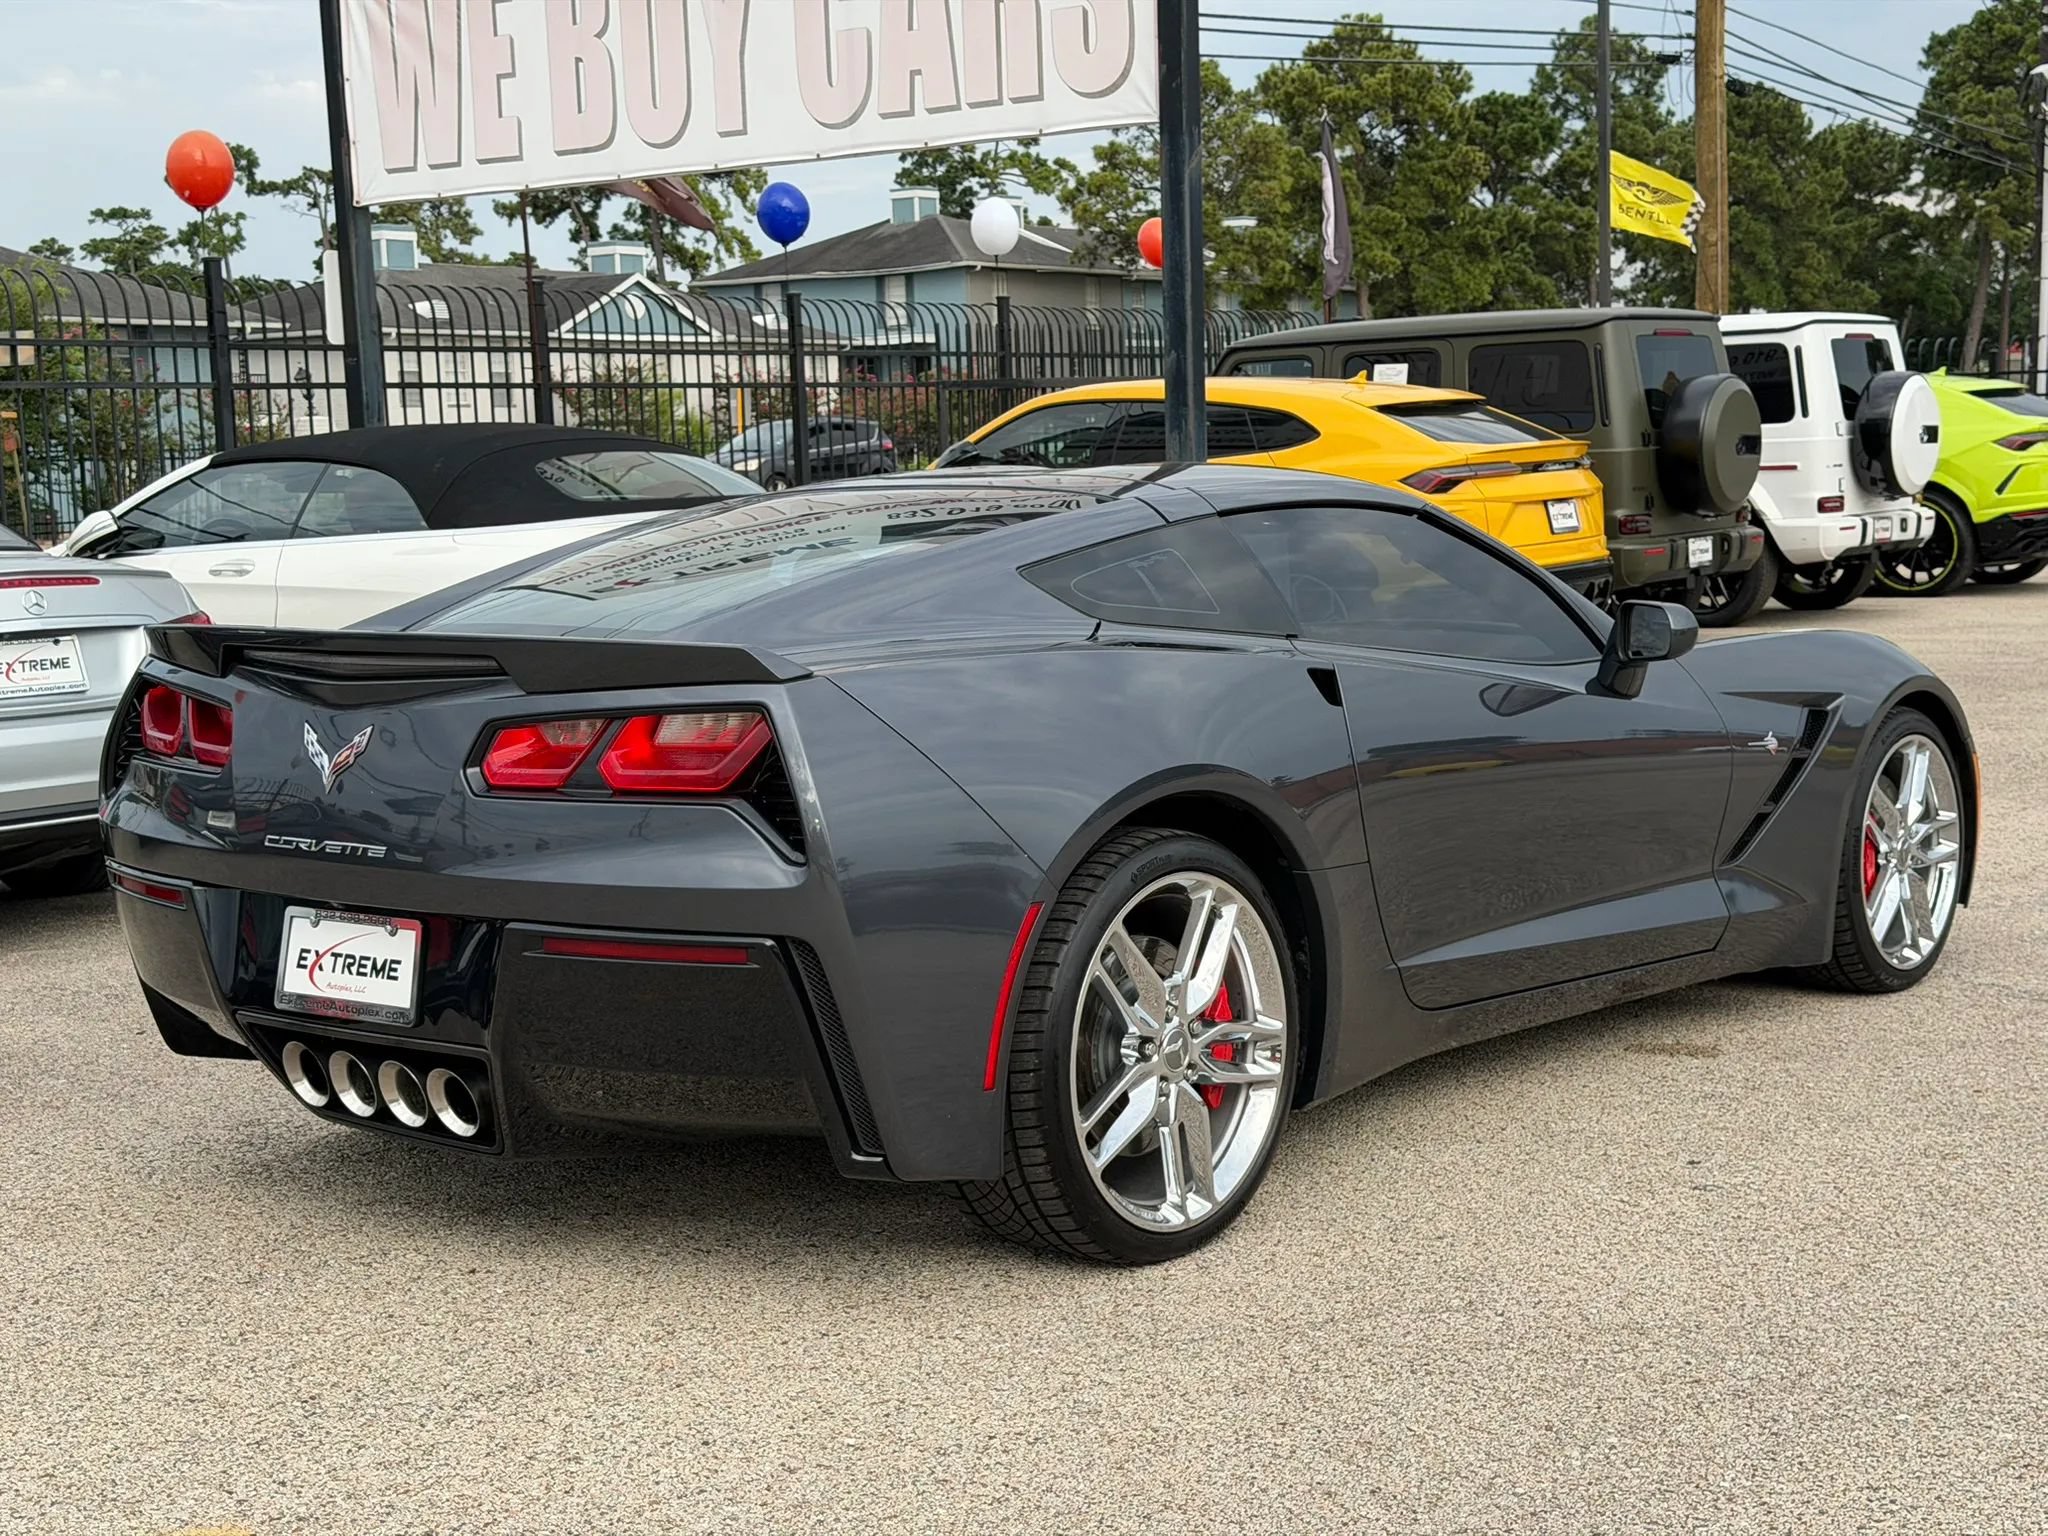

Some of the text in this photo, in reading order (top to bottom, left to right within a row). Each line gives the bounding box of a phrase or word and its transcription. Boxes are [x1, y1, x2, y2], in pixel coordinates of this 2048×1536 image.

[364, 0, 524, 174] WE
[545, 0, 750, 157] BUY
[264, 834, 388, 858] CORVETTE
[296, 947, 402, 982] EXTREME
